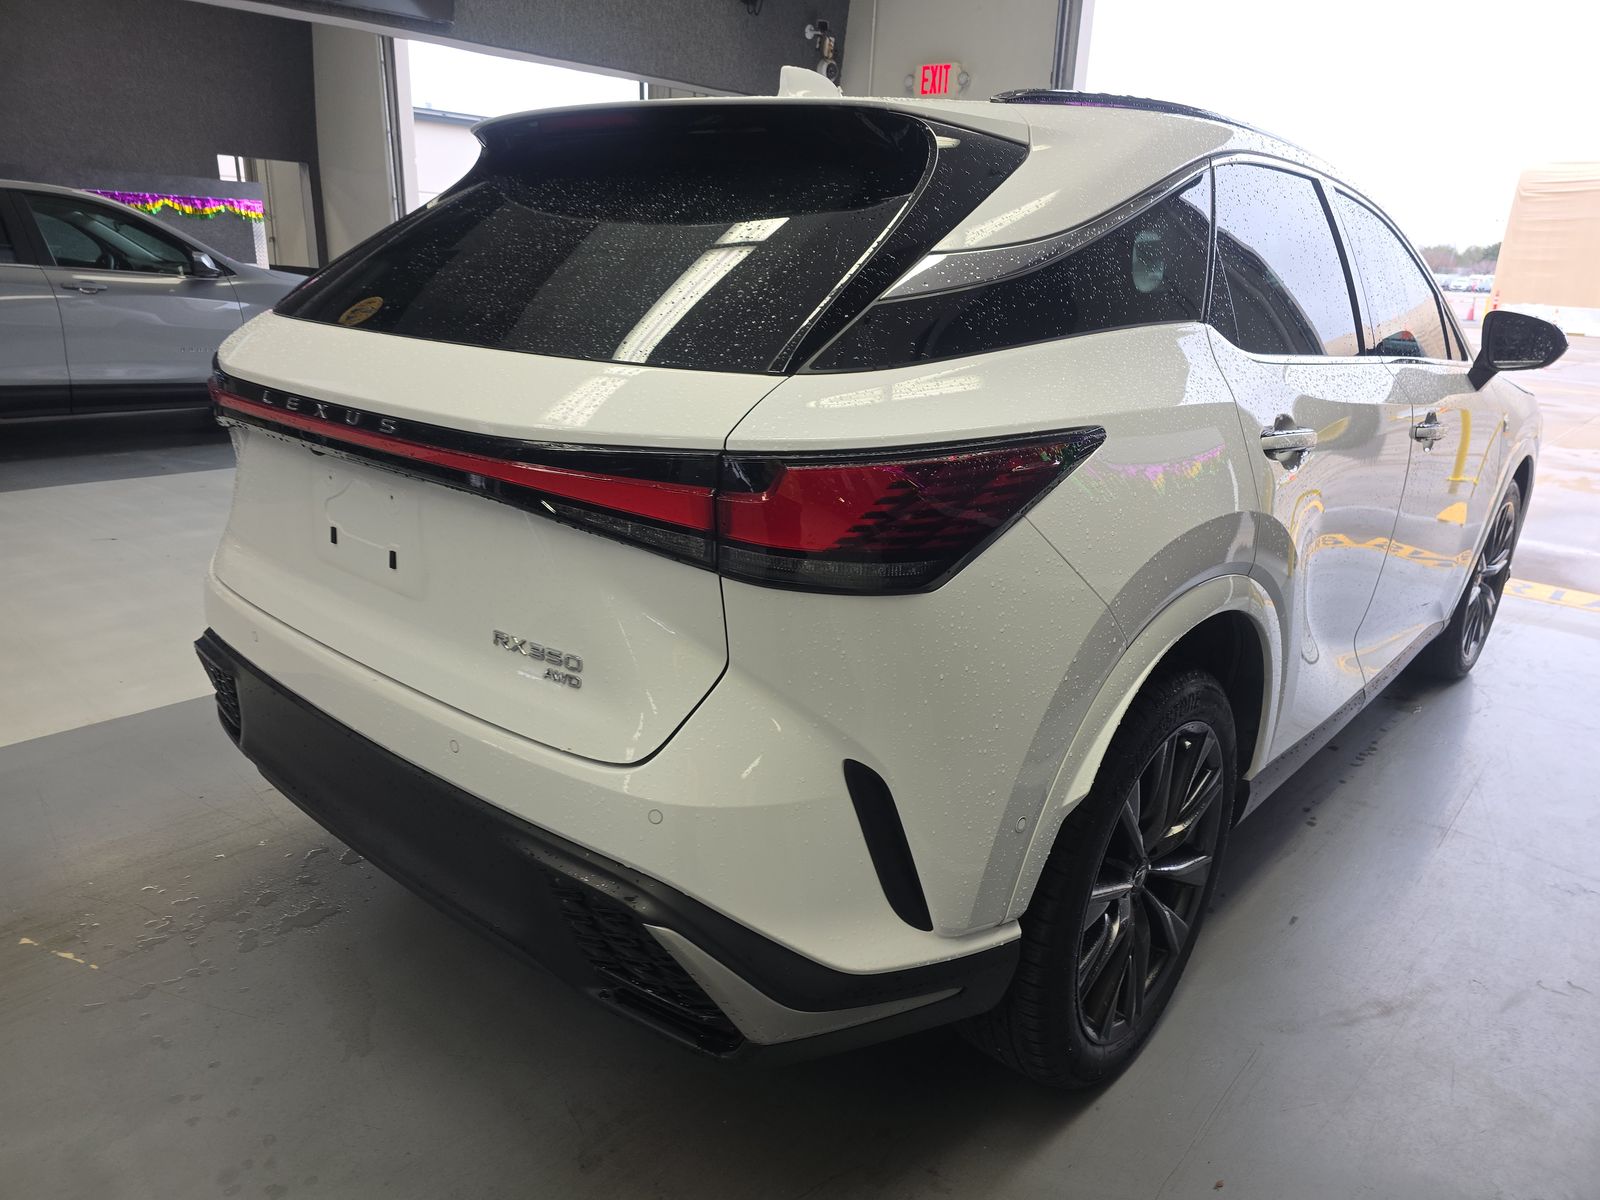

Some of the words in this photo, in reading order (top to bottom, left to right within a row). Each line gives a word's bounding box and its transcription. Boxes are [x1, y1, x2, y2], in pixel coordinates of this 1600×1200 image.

[921, 64, 951, 95] EXIT
[262, 391, 397, 433] LEXUS
[543, 668, 583, 689] AWD
